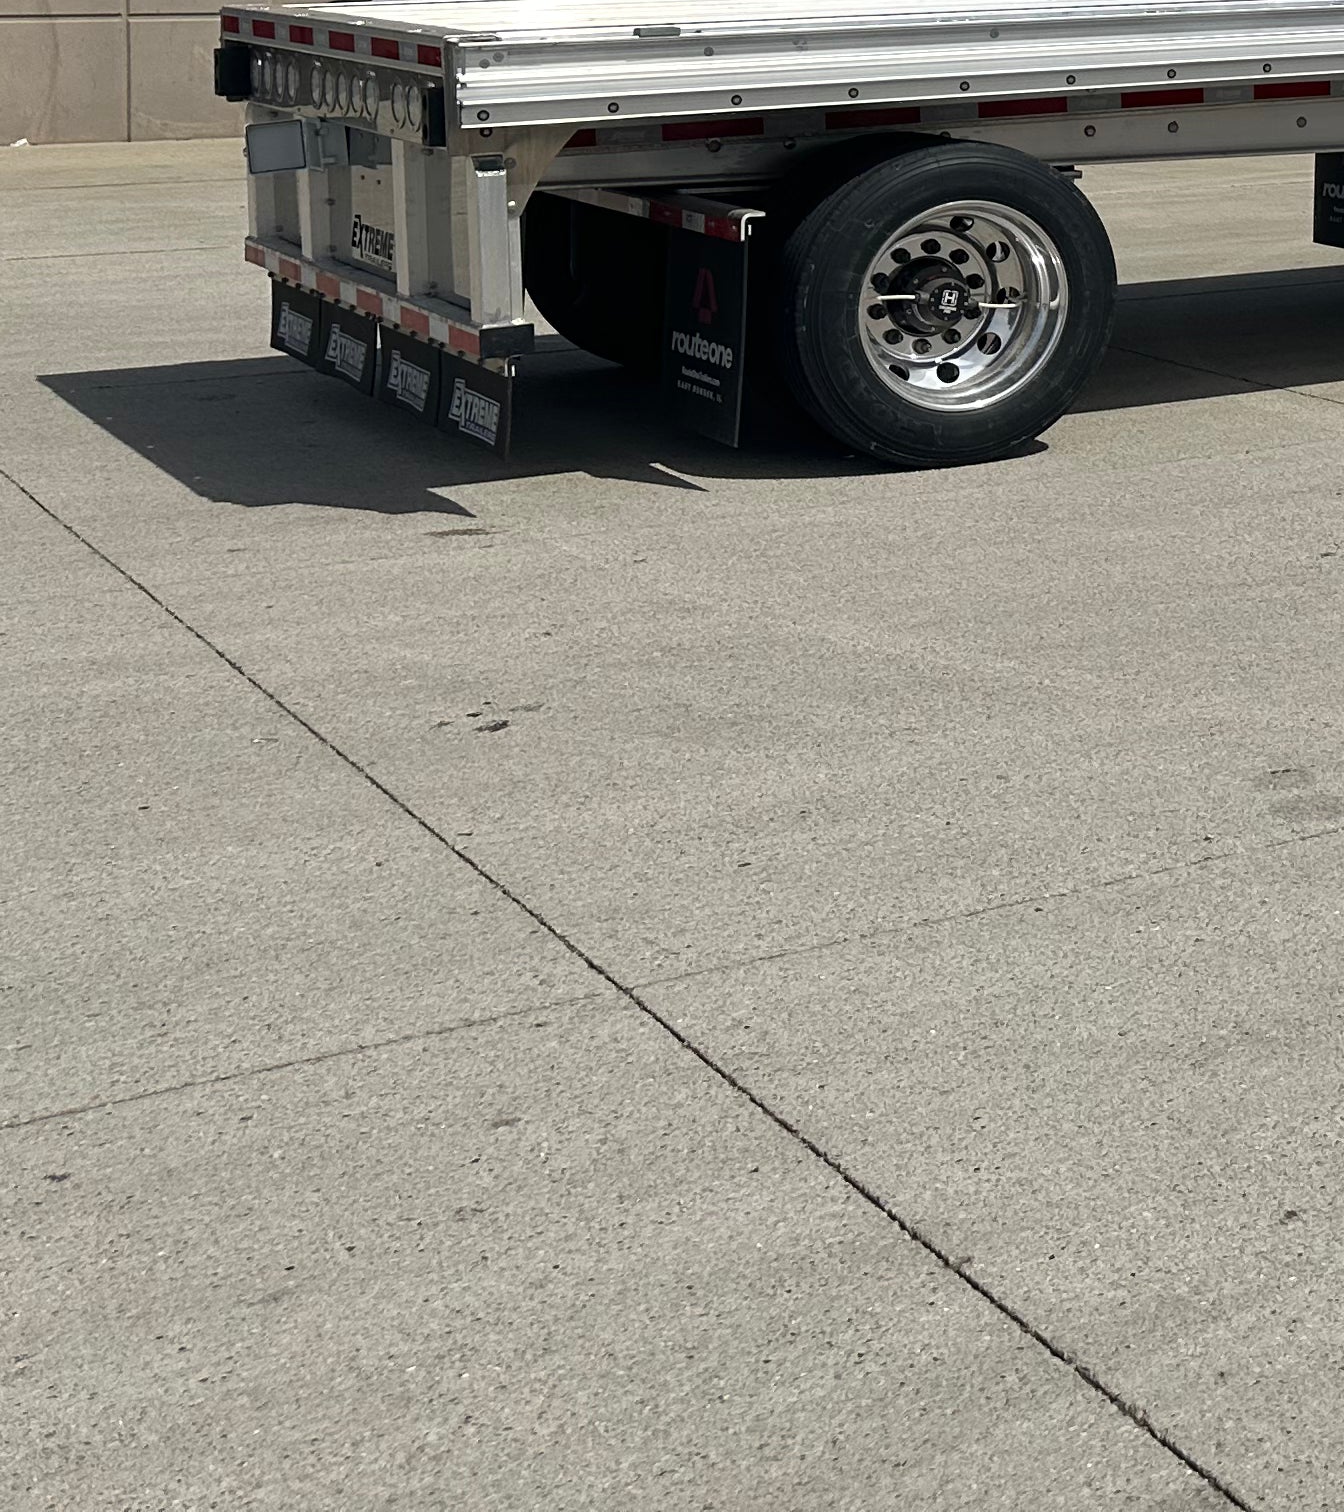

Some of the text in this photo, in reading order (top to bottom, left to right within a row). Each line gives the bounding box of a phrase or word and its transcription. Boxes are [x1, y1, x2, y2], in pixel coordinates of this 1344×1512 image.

[352, 215, 394, 260] EXTREME
[671, 331, 733, 368] routeone
[389, 354, 429, 399] EXTREME
[451, 383, 498, 432] EXTREME
